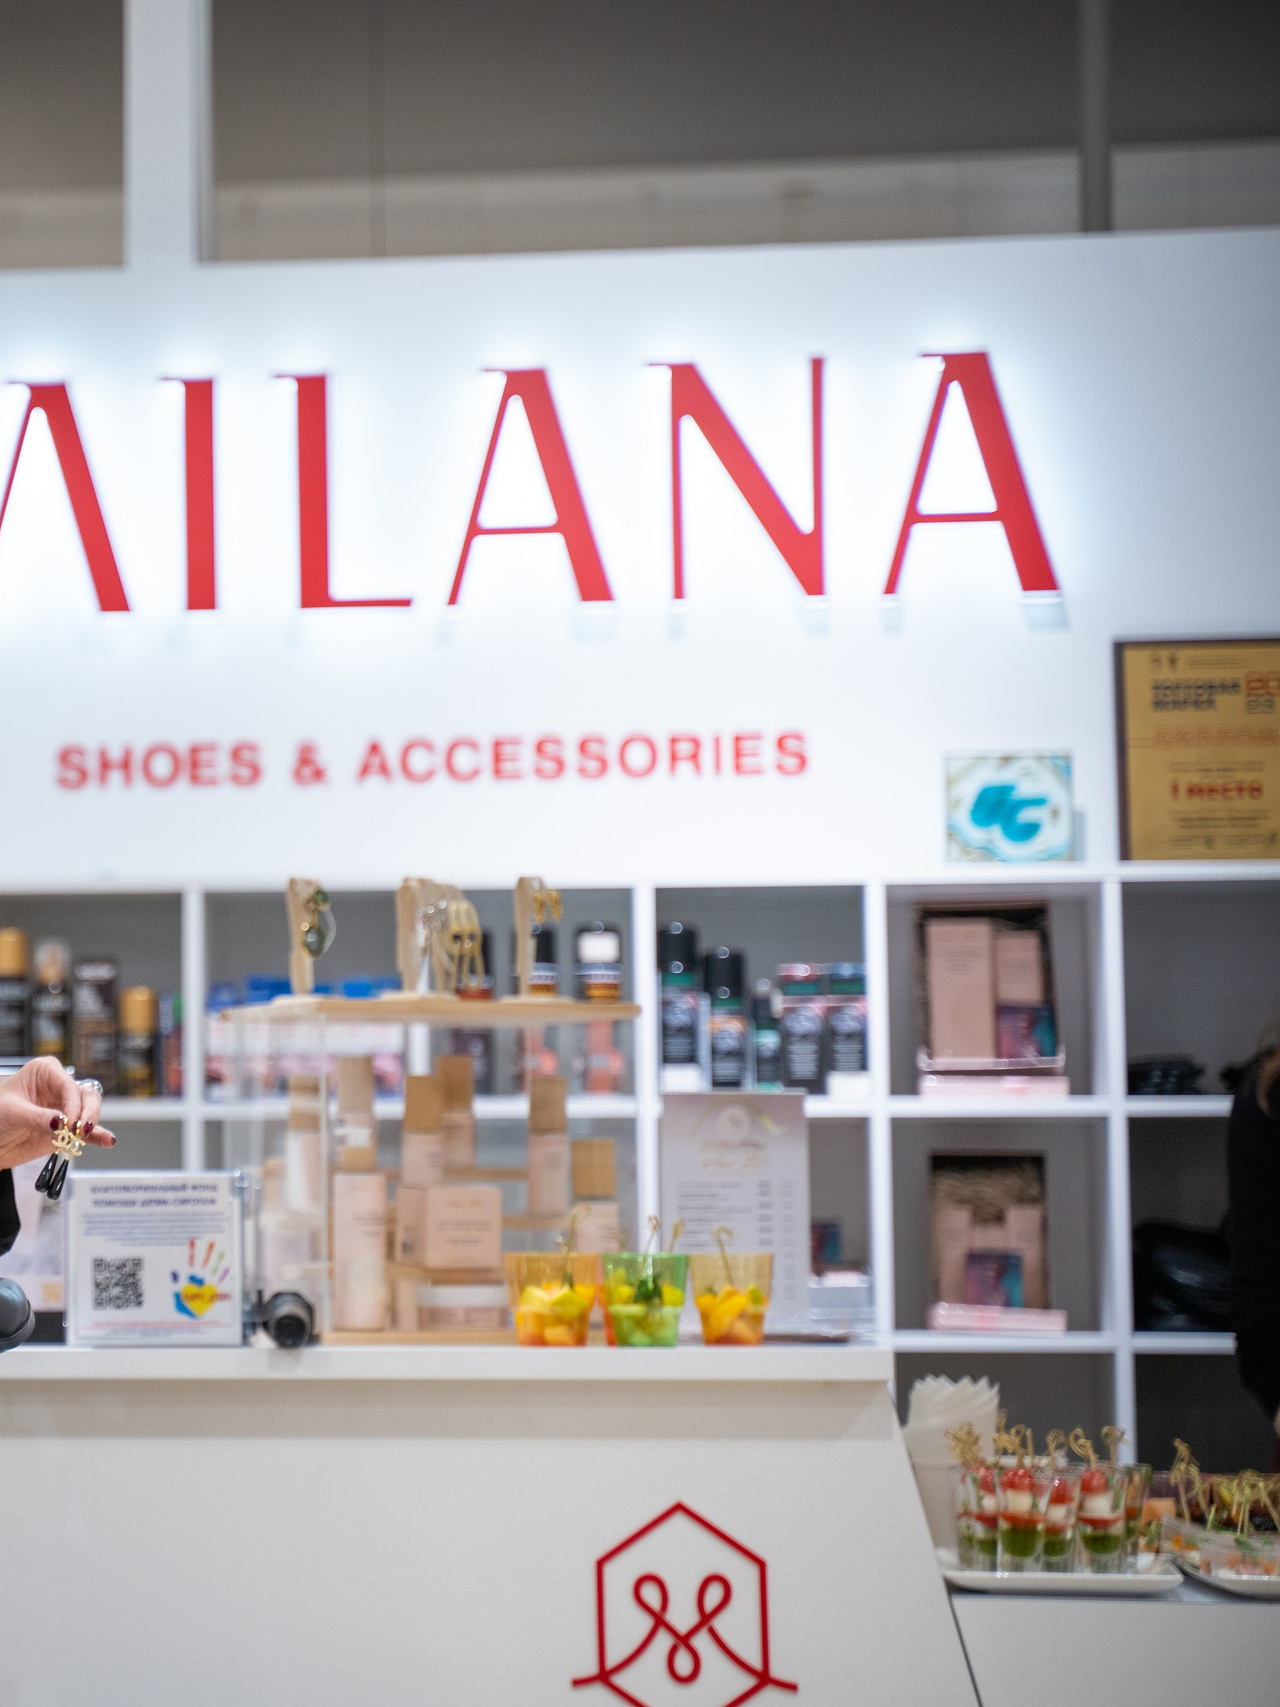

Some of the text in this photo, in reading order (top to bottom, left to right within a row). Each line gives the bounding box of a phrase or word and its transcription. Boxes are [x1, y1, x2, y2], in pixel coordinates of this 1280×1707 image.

[57, 731, 810, 789] SHOES & ACCESSORIES
